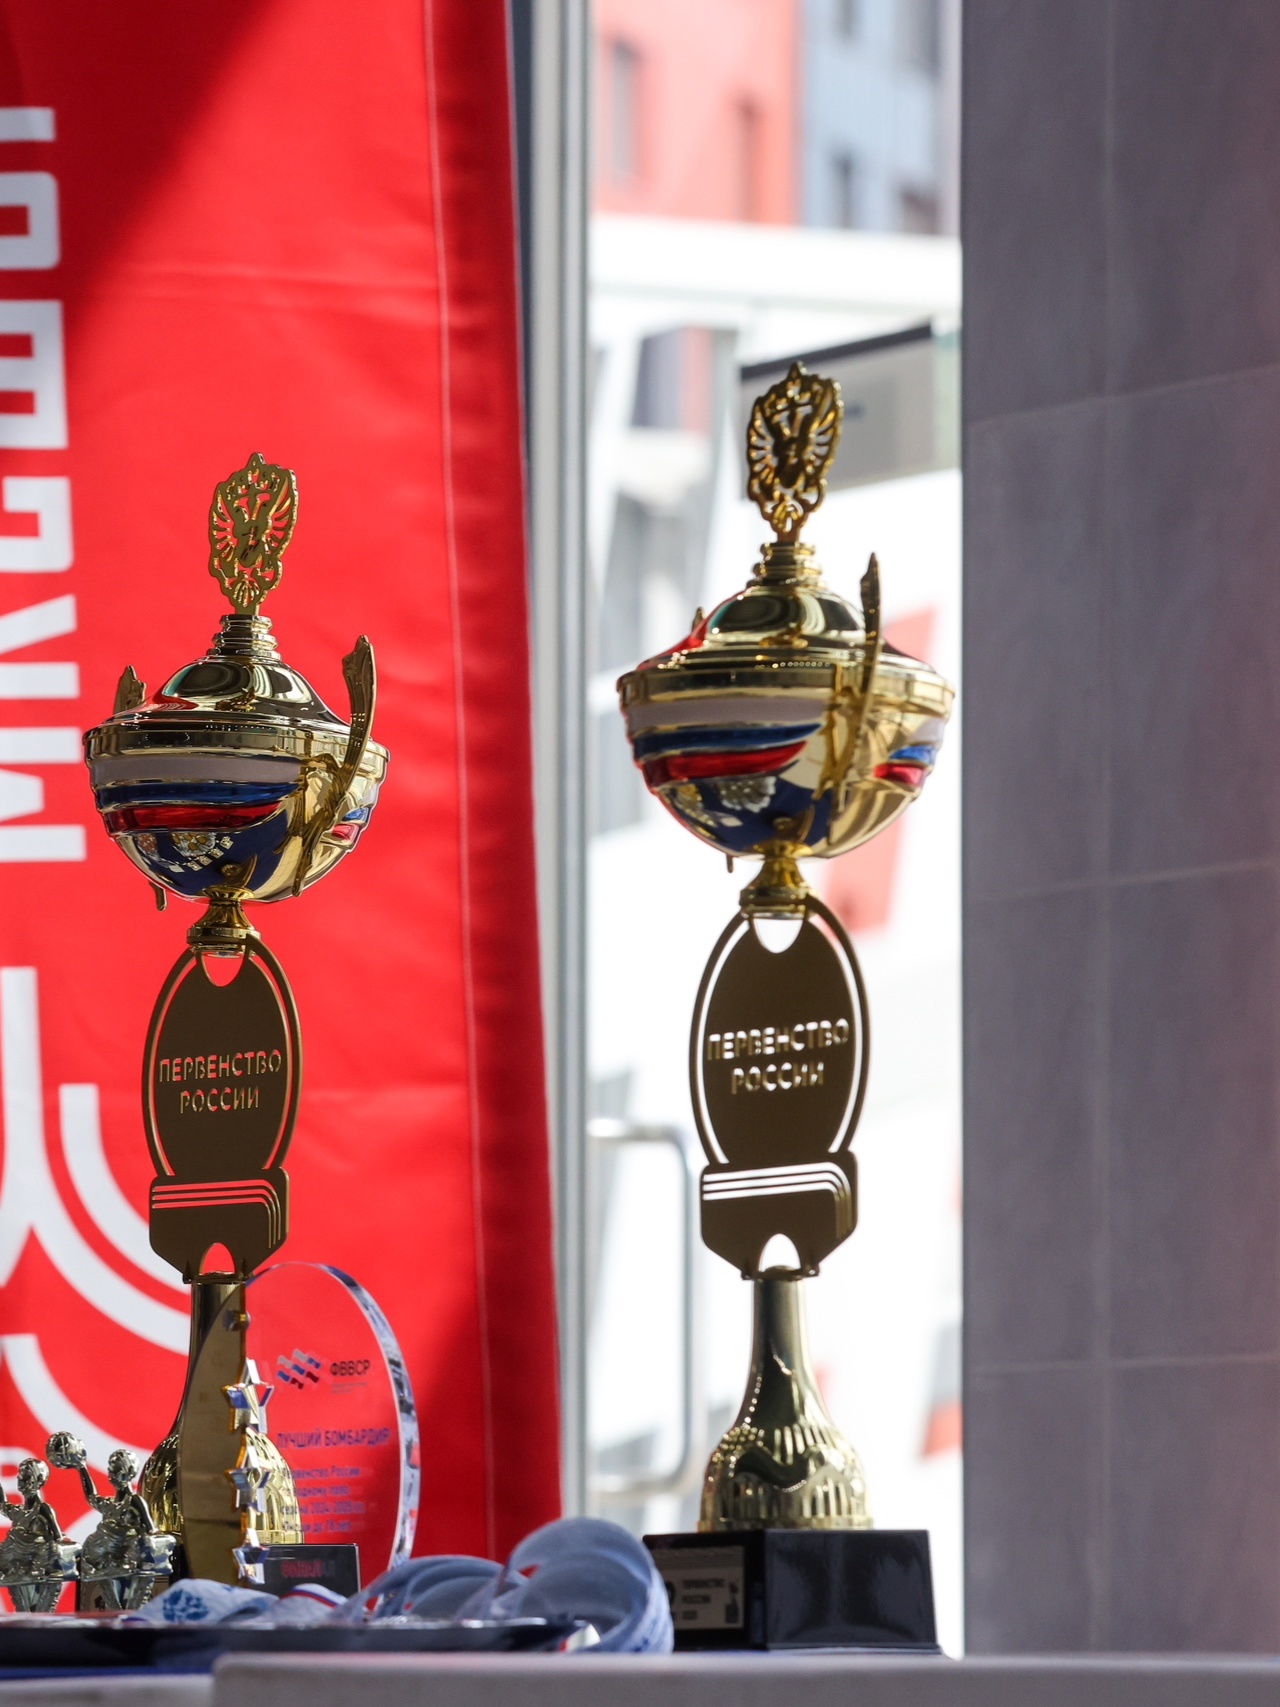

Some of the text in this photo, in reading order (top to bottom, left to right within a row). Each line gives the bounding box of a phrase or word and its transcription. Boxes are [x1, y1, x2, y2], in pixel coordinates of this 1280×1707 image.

[707, 1018, 850, 1061] ПЕРВЕНСТВО
[159, 1049, 282, 1083] ПЕРВЕНСТВО
[731, 1061, 825, 1095] РОССИИ
[180, 1086, 260, 1114] РОССИИ
[277, 1428, 322, 1449] ЛУЧШИЙ
